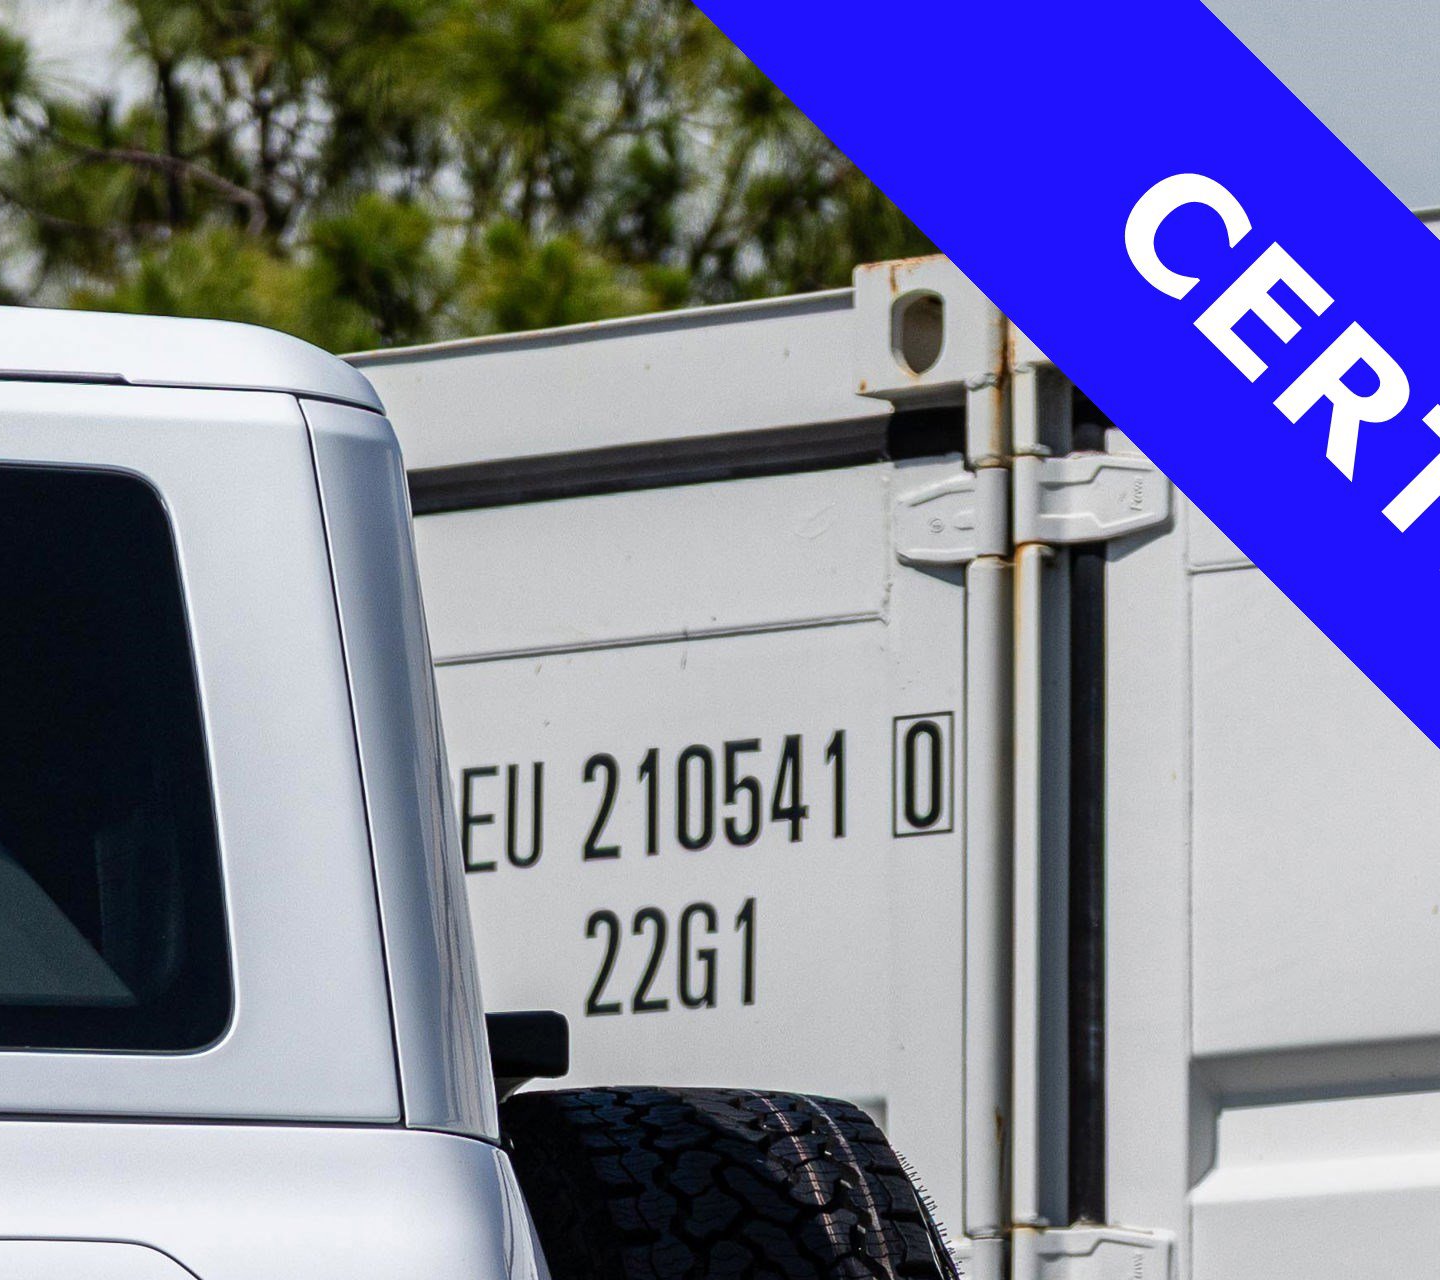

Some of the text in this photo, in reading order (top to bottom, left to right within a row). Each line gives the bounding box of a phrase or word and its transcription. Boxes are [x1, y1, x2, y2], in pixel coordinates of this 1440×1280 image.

[461, 719, 944, 875] EU 210541 0
[583, 896, 757, 1018] 22G1
